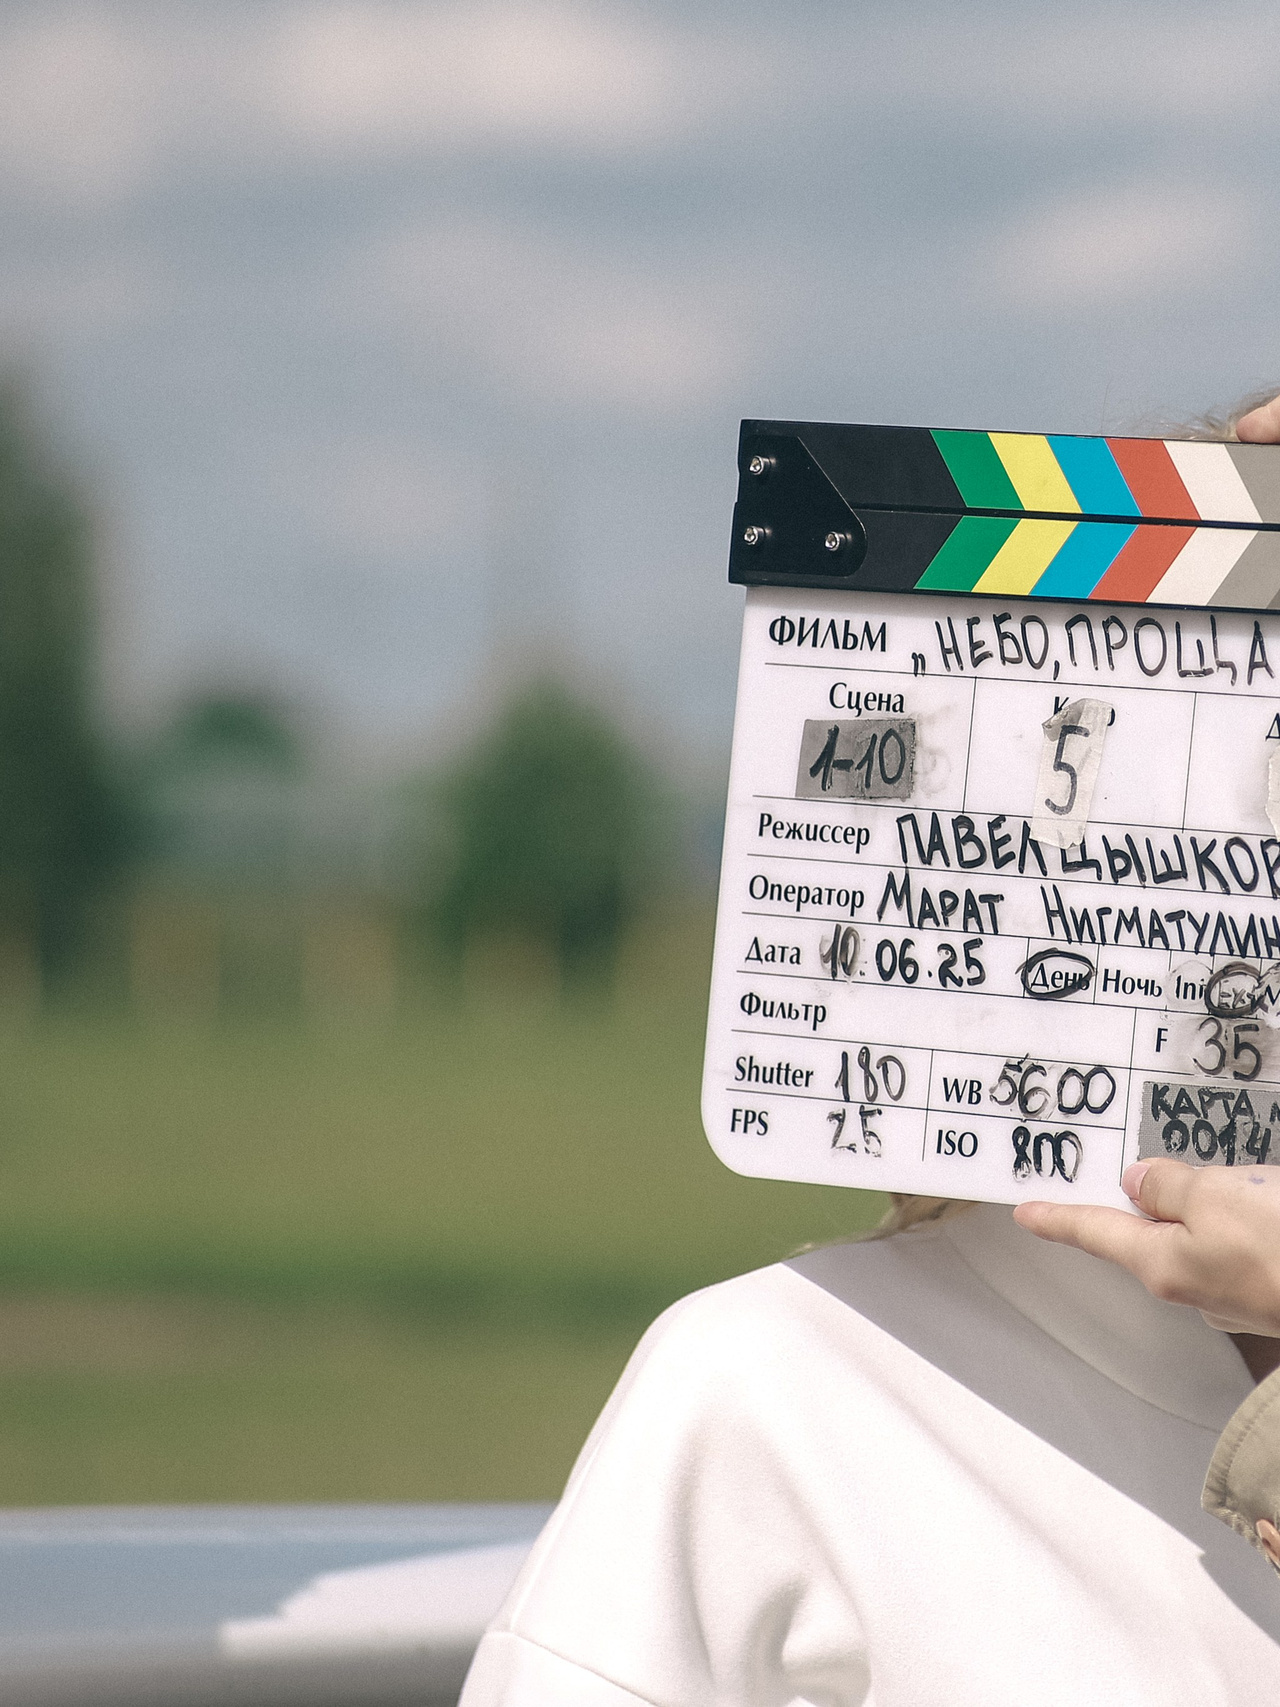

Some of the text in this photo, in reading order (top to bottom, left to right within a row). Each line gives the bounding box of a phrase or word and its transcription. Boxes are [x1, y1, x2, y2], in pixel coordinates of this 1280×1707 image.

[768, 615, 887, 653] ФИЛЬМ
[828, 681, 906, 718] Сцена
[808, 724, 906, 792] 1-10
[1044, 724, 1091, 816] 5
[757, 812, 871, 854] Режиссер
[896, 811, 1048, 877] ПАВЕЛ
[748, 874, 866, 918] Оператор
[744, 935, 802, 966] Дата
[1029, 962, 1092, 992] День
[1102, 970, 1163, 999] Ночь
[739, 991, 828, 1032] Фильтр
[1155, 1027, 1169, 1053] F
[1192, 1016, 1262, 1082] 35
[734, 1055, 815, 1089] Shutter
[834, 1046, 907, 1104] 180
[941, 1076, 983, 1106] WB
[729, 1107, 769, 1137] FPS
[935, 1128, 979, 1158] ISO
